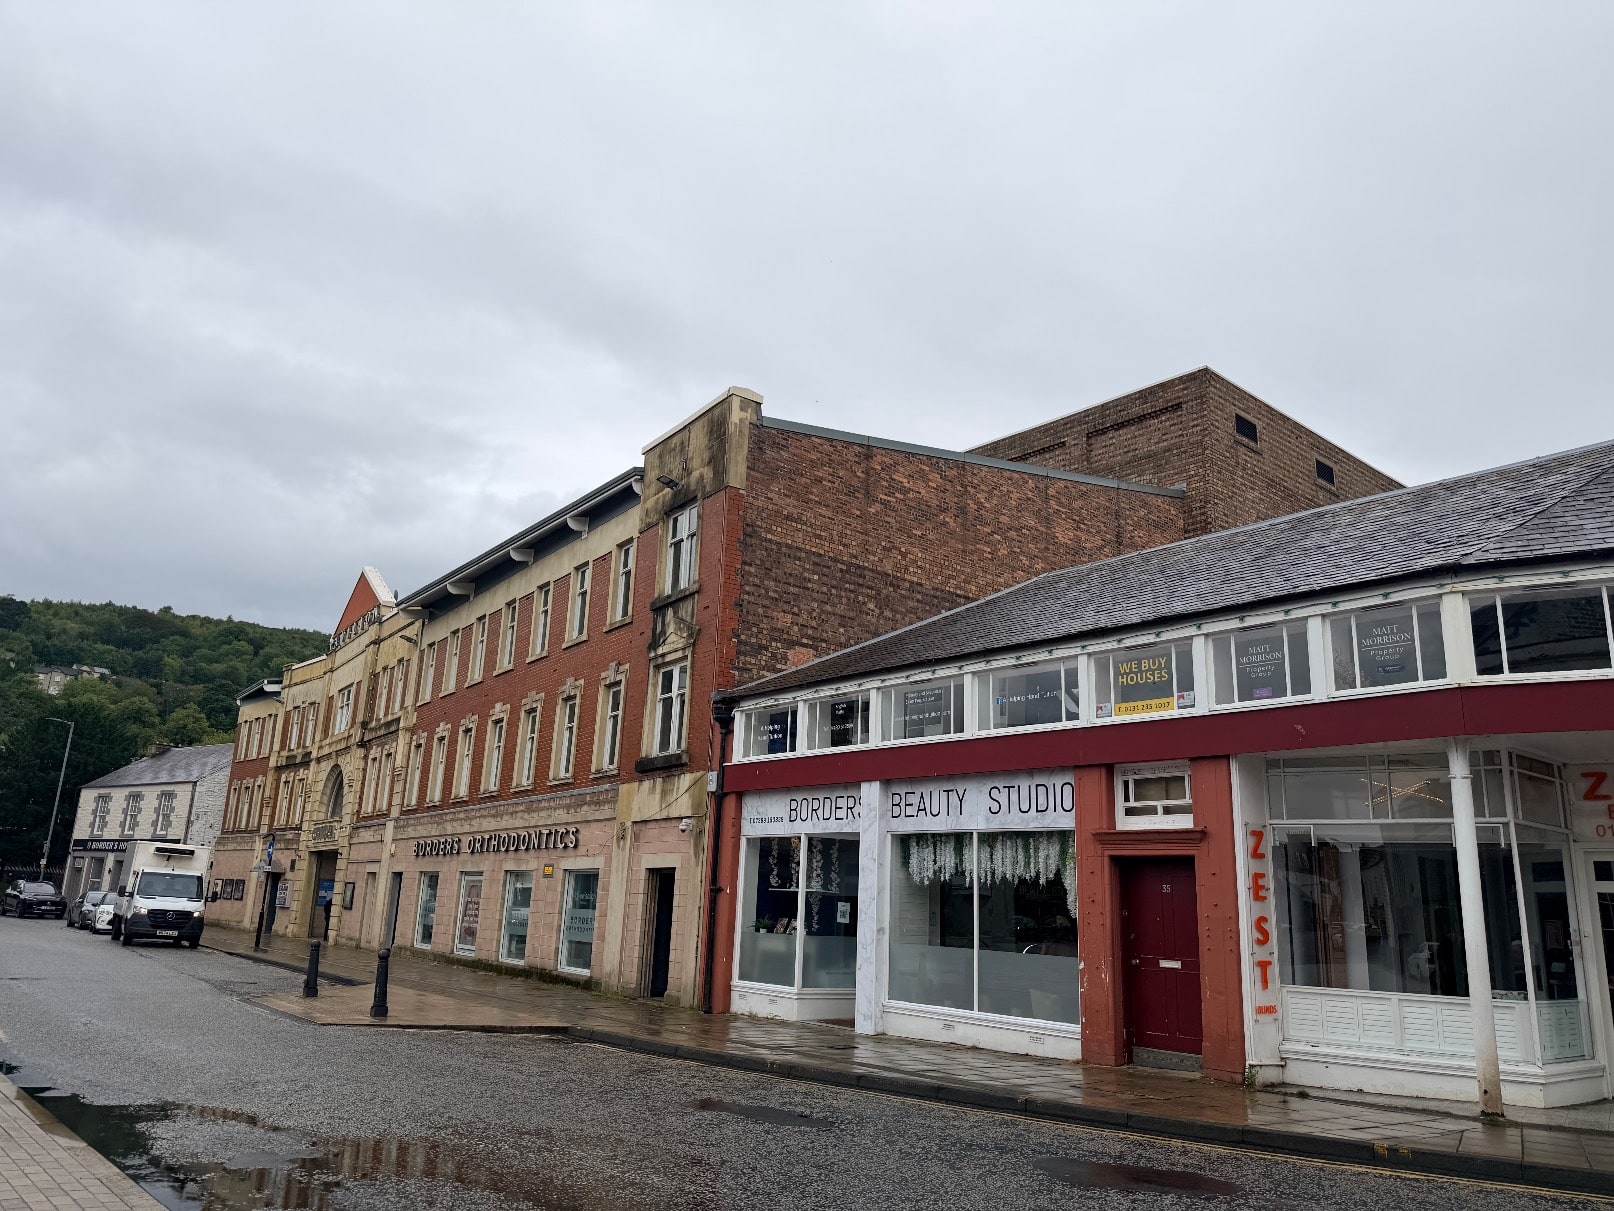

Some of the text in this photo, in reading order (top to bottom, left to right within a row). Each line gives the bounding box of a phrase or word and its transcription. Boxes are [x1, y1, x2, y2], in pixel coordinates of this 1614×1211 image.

[1372, 624, 1399, 636] MATT
[1361, 632, 1411, 647] MORRISON
[1248, 644, 1271, 654] MATT
[1370, 647, 1404, 656] Property
[1239, 651, 1282, 663] MORRISON
[1118, 656, 1167, 674] WE BUY
[1246, 665, 1275, 673] Property
[1118, 669, 1169, 686] HOUSES
[788, 782, 1075, 822] BORDER BEAUTY STUDIO
[412, 826, 579, 856] BORDERS ORTHODONTICS
[1162, 884, 1171, 893] 35
[570, 916, 593, 925] BORDER
